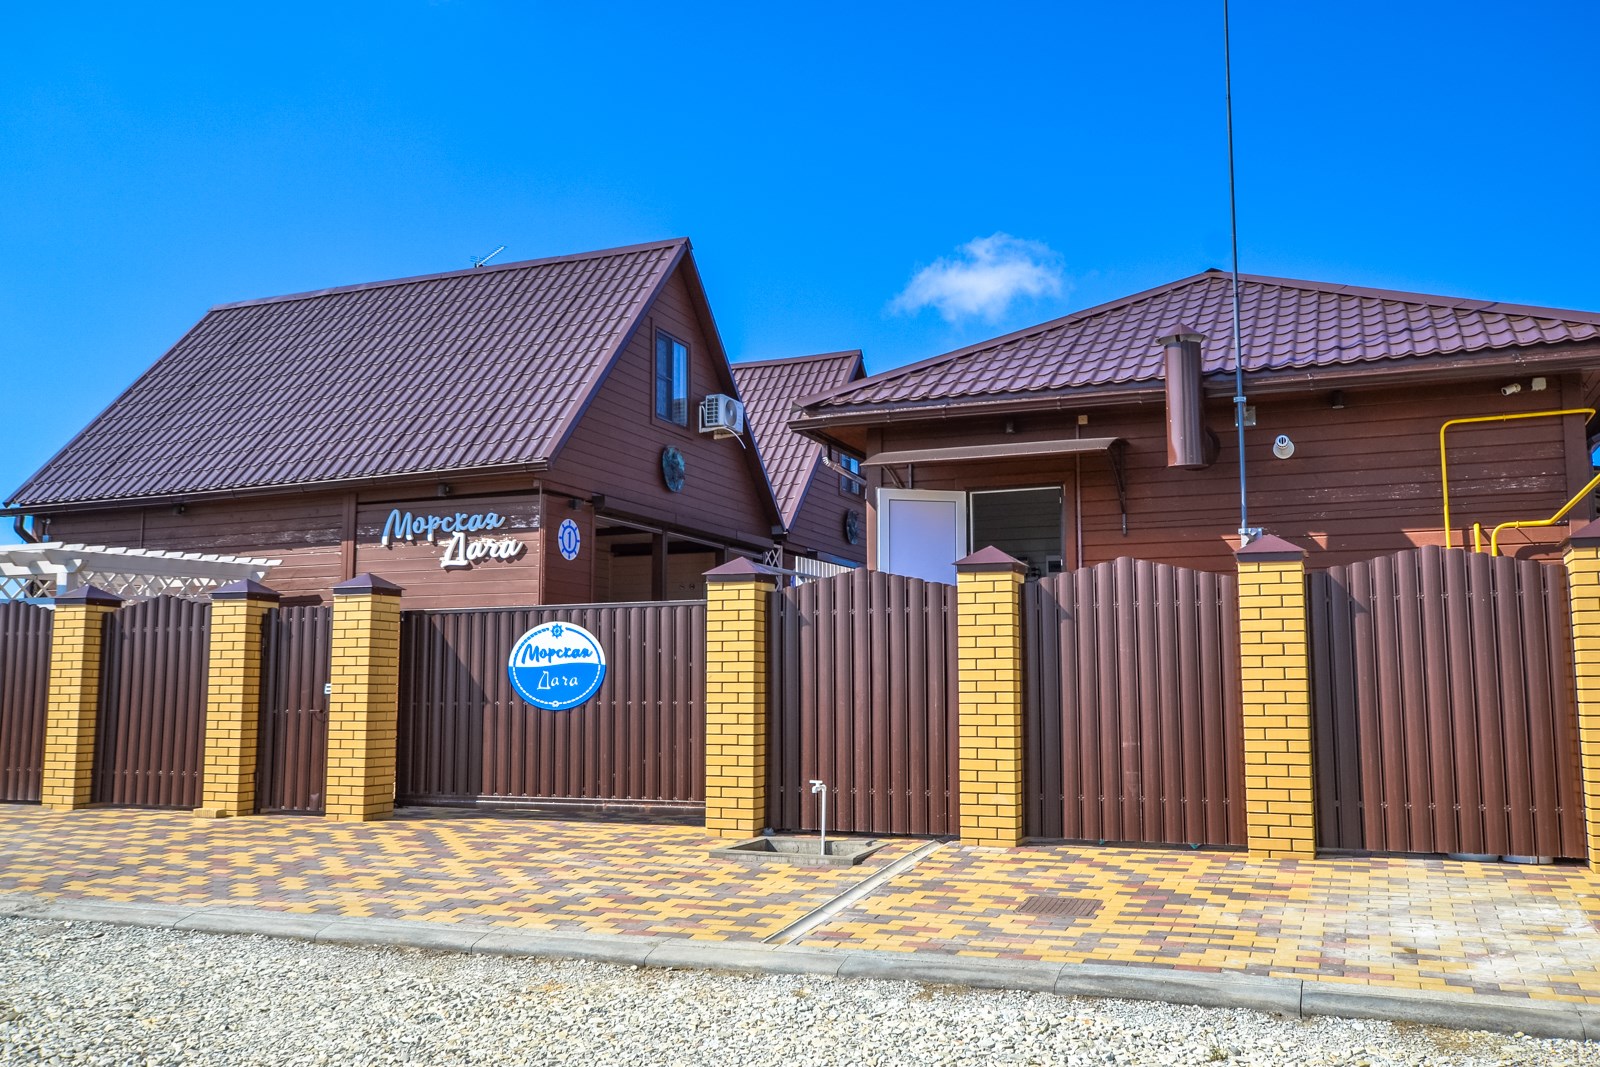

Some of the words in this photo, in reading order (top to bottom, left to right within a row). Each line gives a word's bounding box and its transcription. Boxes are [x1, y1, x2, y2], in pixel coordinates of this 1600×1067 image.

[381, 508, 506, 546] Морская
[440, 530, 524, 568] Дача
[521, 643, 593, 665] Морская
[536, 670, 578, 690] Дача
